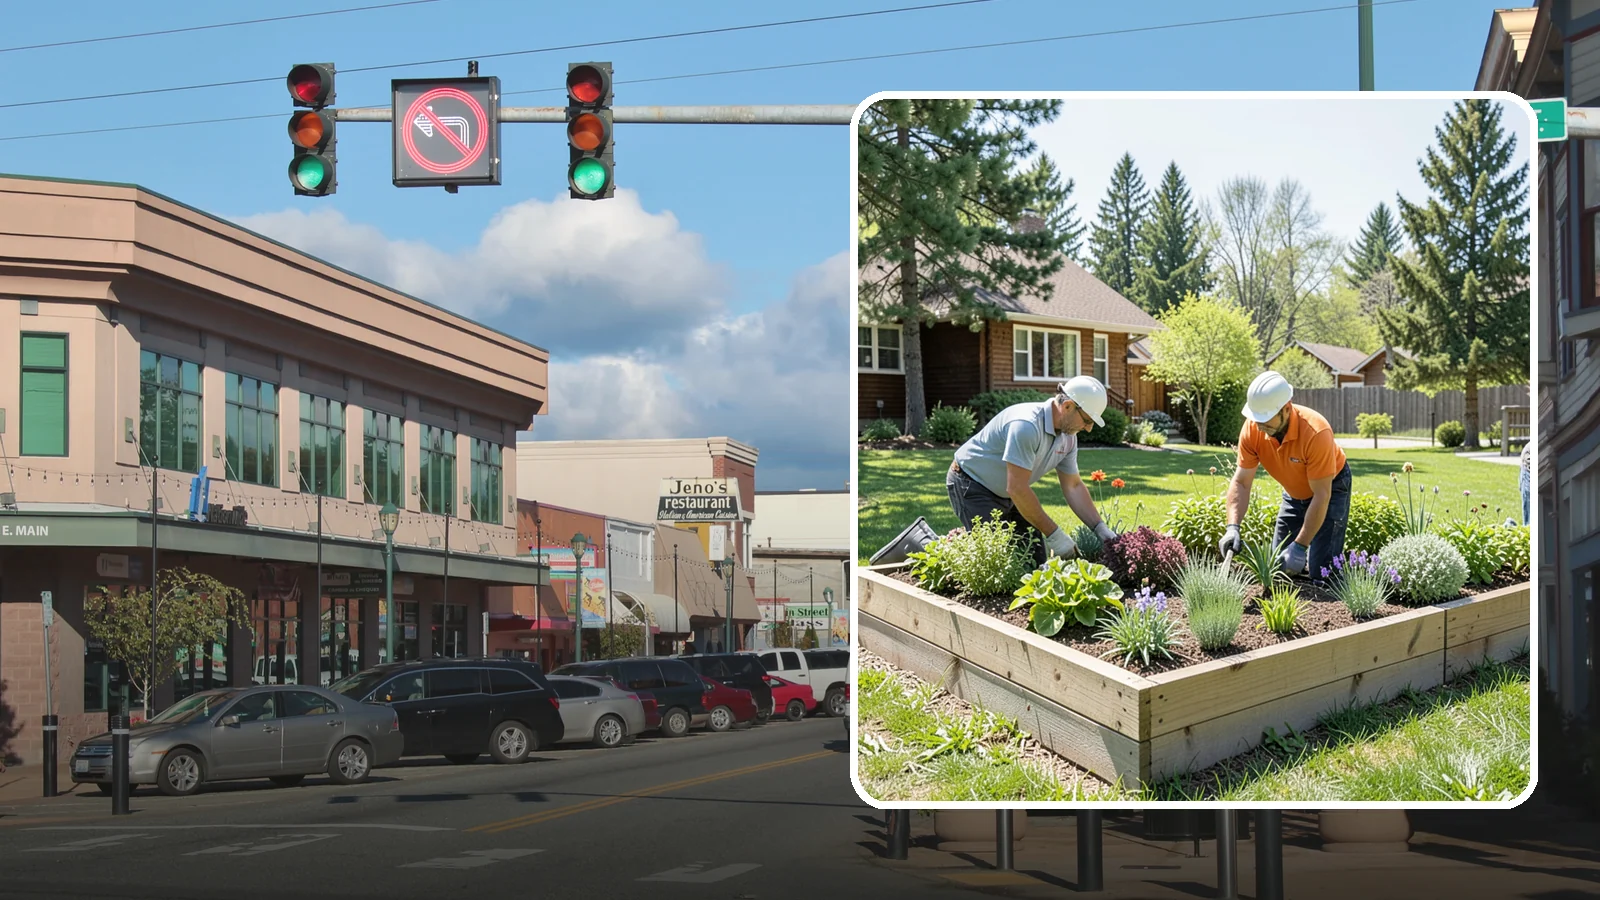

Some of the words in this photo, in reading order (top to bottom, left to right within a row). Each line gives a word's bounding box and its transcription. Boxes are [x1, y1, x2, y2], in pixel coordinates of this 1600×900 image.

[669, 479, 727, 494] Jeno's
[665, 496, 731, 509] restaurant
[658, 510, 682, 520] Italian
[686, 509, 714, 519] American
[715, 510, 737, 519] Cuisine
[2, 525, 13, 536] E.
[15, 525, 49, 536] MAIN
[797, 607, 829, 616] Street
